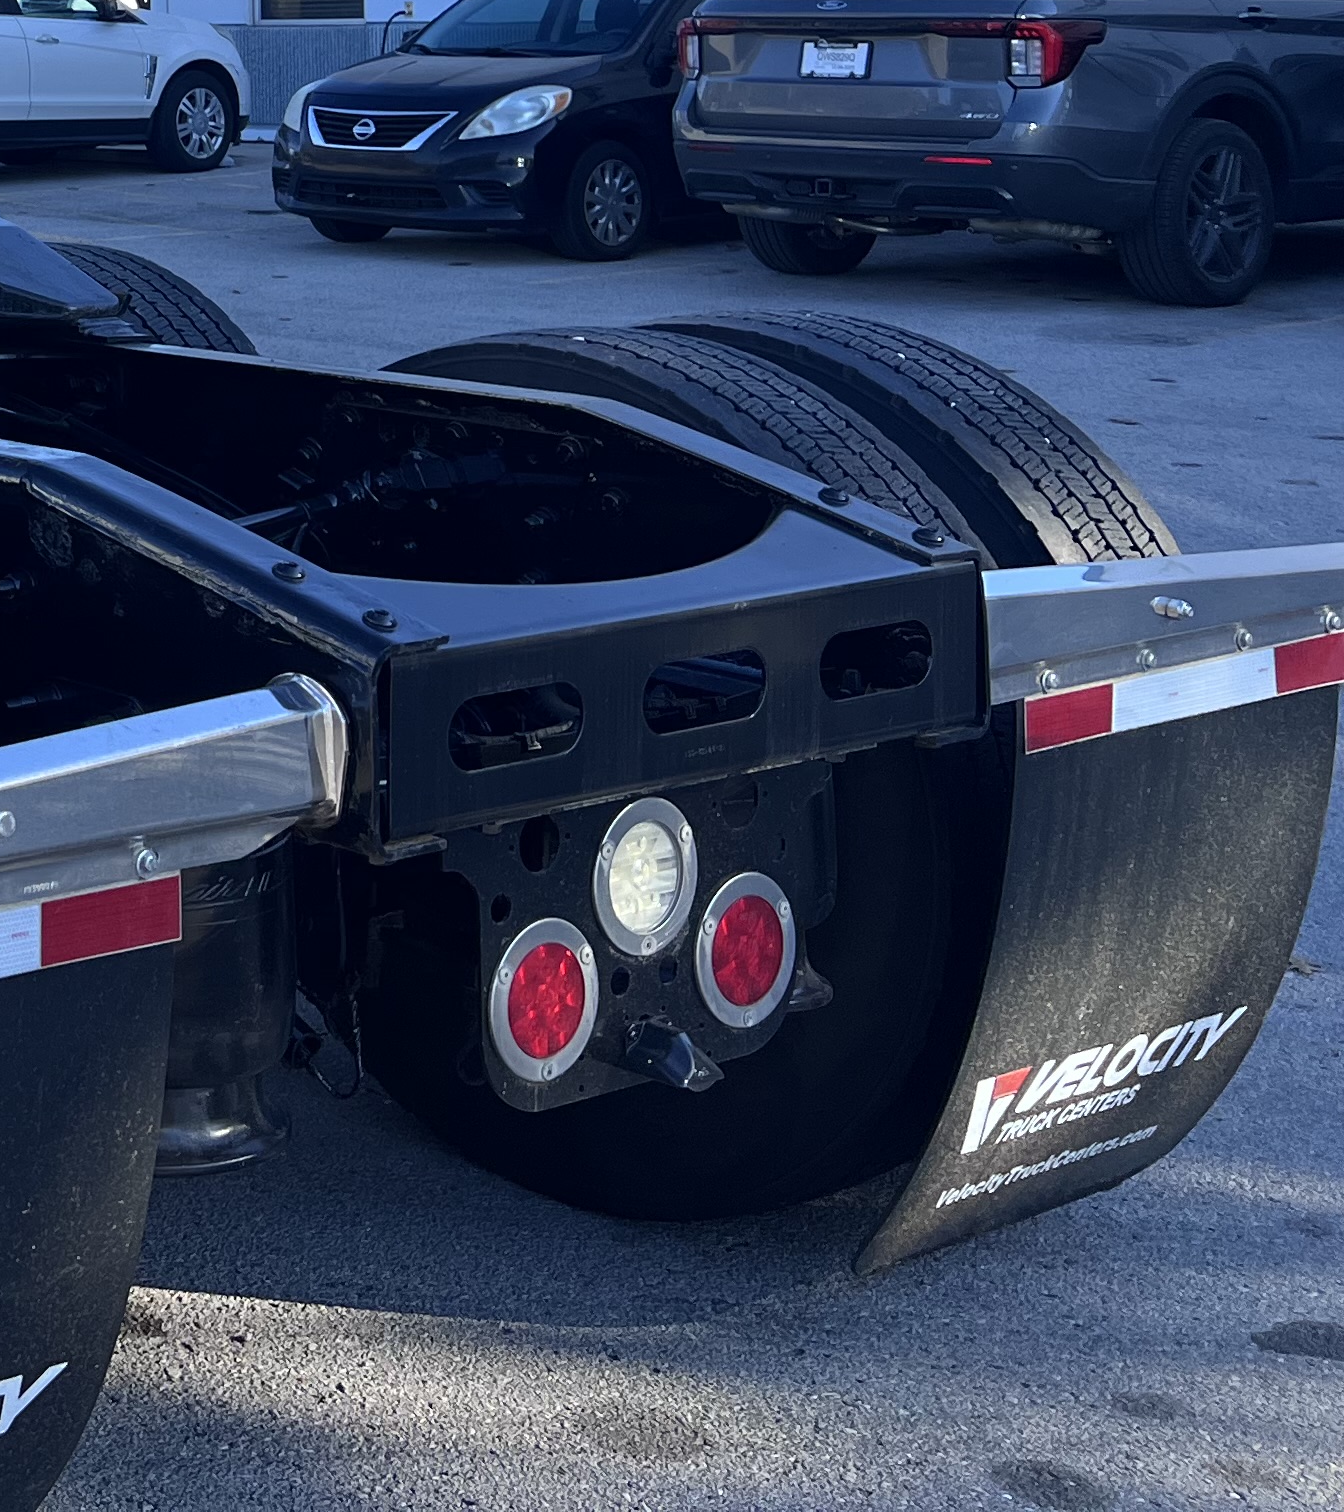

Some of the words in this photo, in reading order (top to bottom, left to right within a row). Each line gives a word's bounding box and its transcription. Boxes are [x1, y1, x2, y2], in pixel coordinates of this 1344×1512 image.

[1015, 1005, 1247, 1113] VELOCITY
[994, 1107, 1061, 1144] TRUCK
[1056, 1084, 1141, 1125] CENTERS
[935, 1125, 1158, 1209] VelocityTruckCenters.com
